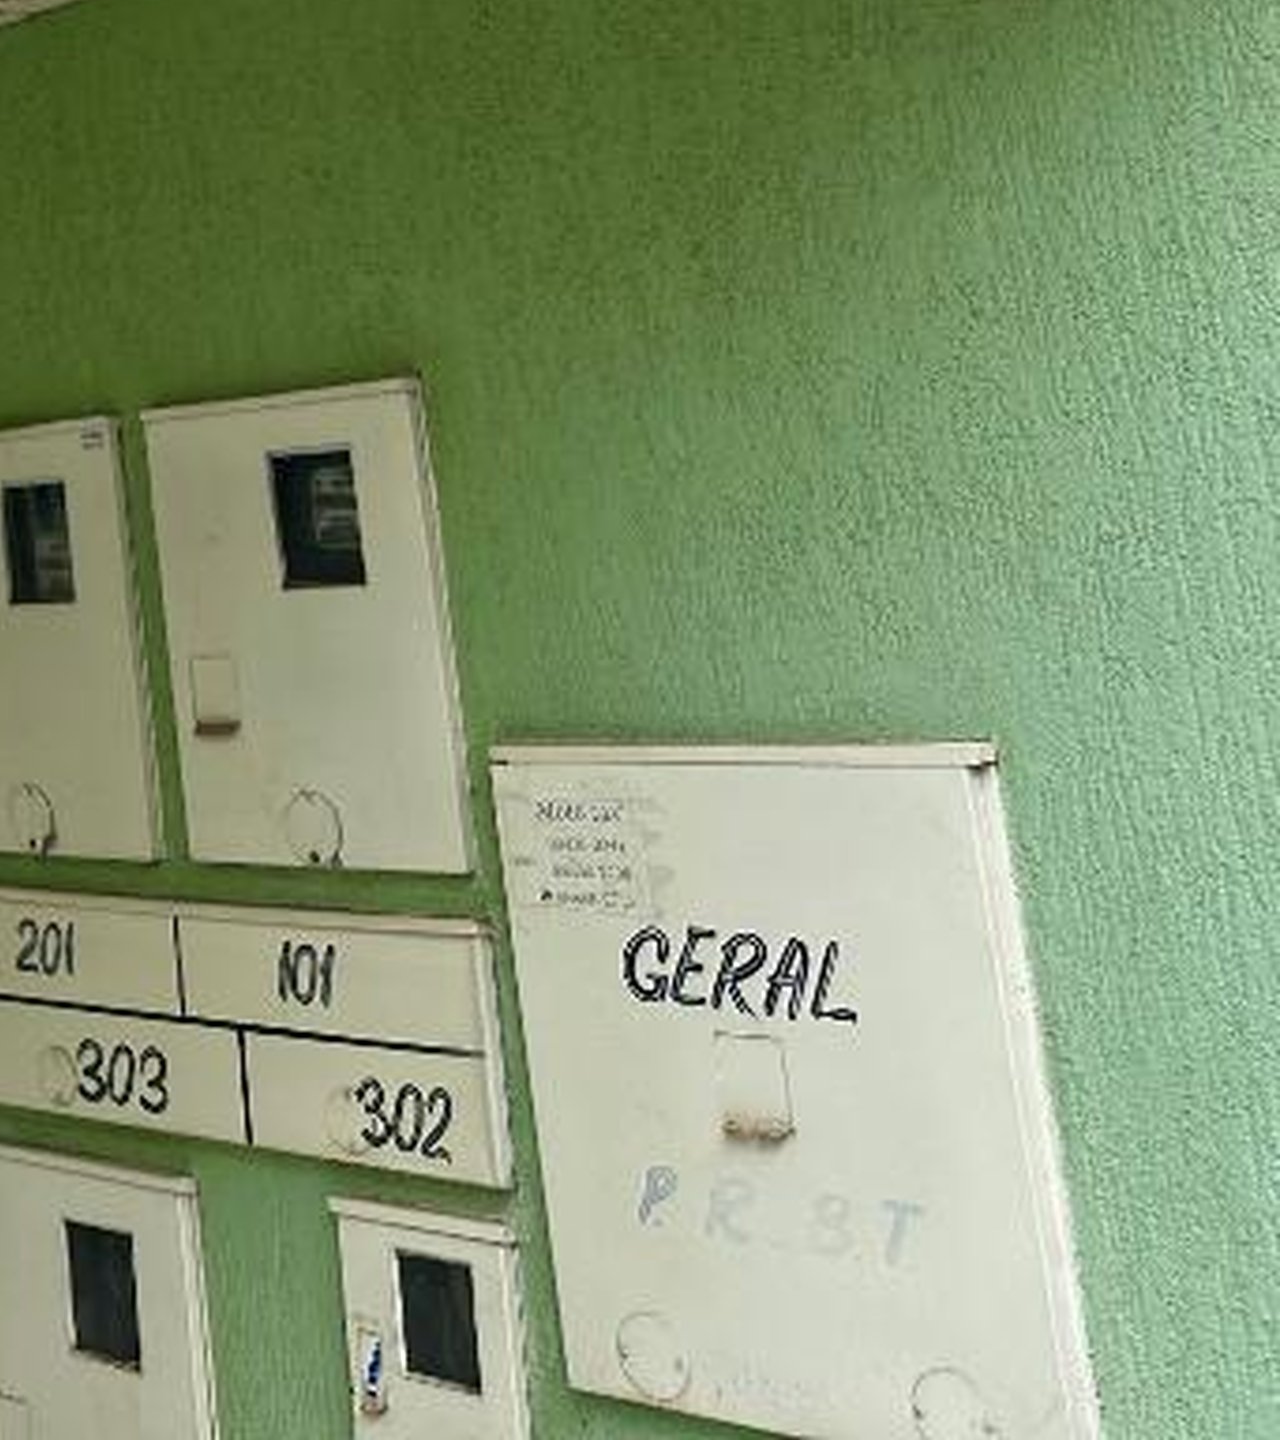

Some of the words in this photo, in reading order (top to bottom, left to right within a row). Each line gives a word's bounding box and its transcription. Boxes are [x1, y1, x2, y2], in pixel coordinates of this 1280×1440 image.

[15, 919, 74, 975] 201
[277, 940, 335, 1008] 101
[623, 924, 858, 1024] GERAL
[76, 1039, 168, 1114] 303
[354, 1075, 453, 1165] 302
